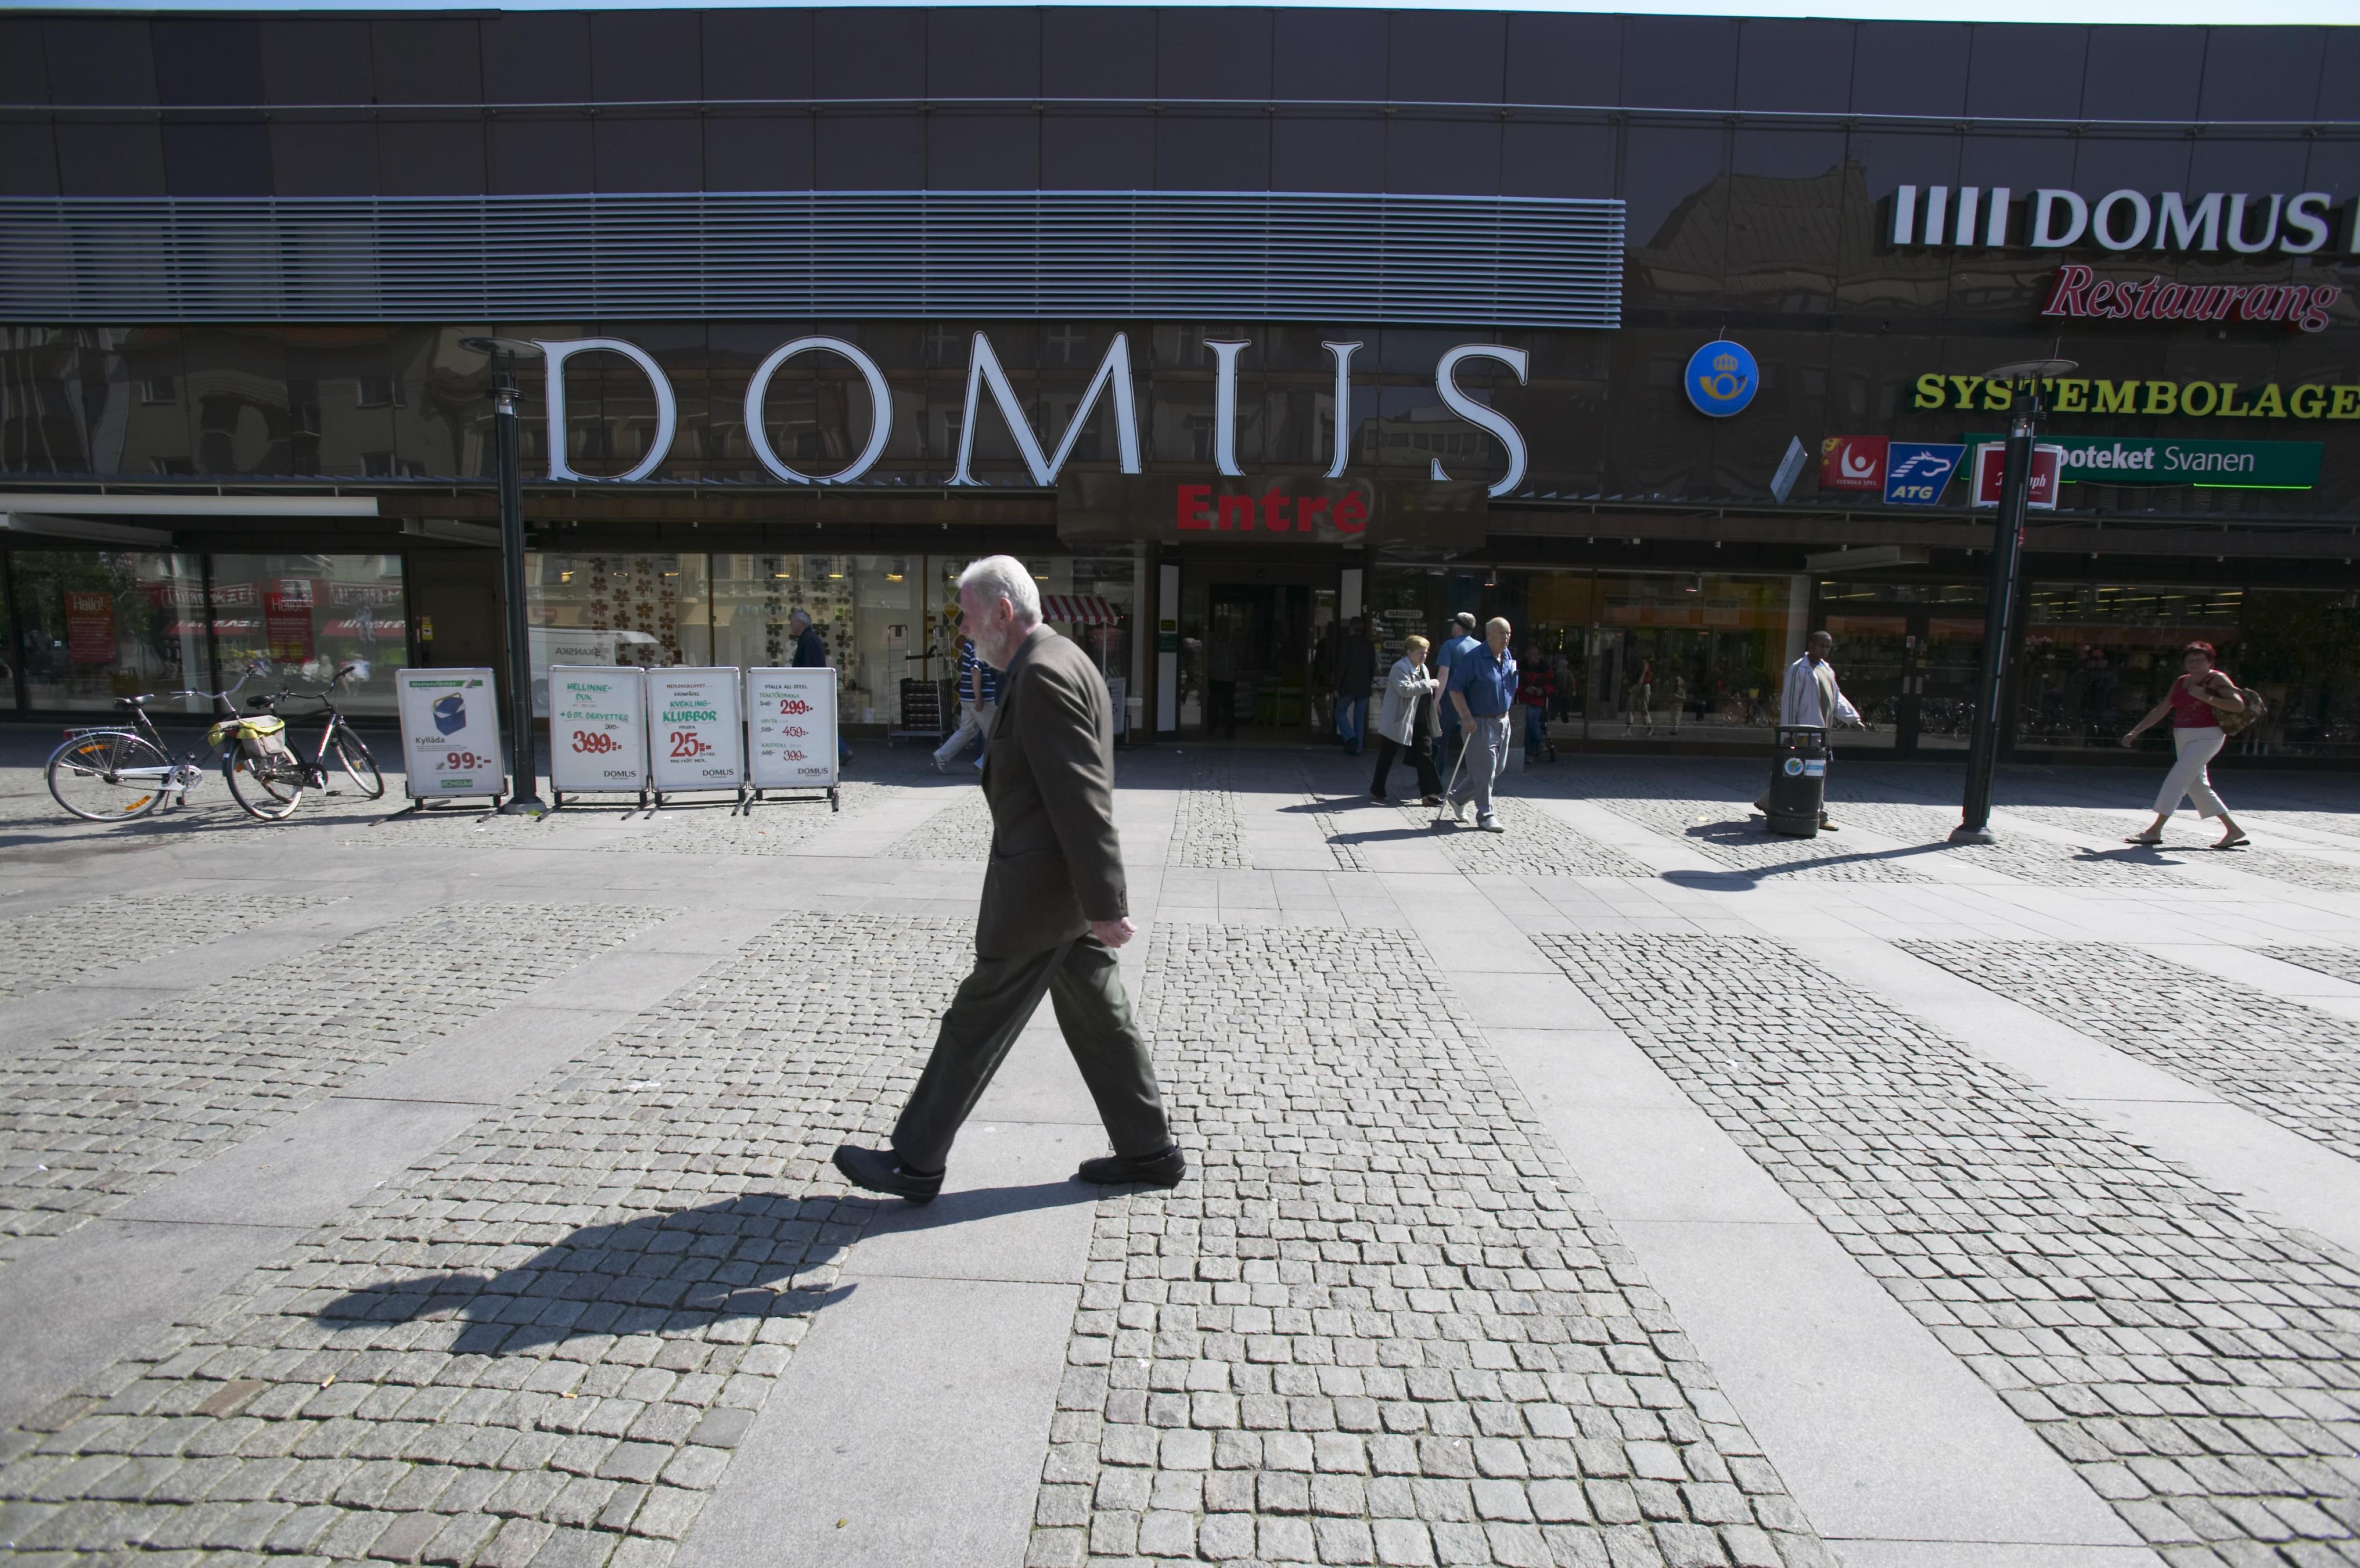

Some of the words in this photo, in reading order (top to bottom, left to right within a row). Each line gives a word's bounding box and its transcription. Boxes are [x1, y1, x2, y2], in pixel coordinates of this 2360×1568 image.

[2031, 188, 2332, 253] DOMUS
[2042, 265, 2341, 333] Restaurang
[530, 330, 1529, 498] DOMUS
[2059, 443, 2155, 470] oteket
[2164, 445, 2255, 472] Svanen
[1891, 485, 1940, 500] ATG
[1177, 484, 1367, 533] Entré
[73, 596, 104, 611] Hello!
[272, 596, 303, 612] Hello!
[567, 682, 613, 692] HELLINNE-
[575, 693, 594, 701] DUK
[670, 700, 711, 708] KYCKLING-
[780, 699, 814, 715] 299:-
[585, 712, 629, 722] SERVETTER
[663, 710, 717, 722] KLUBBOR
[782, 726, 809, 738] 459:-
[415, 736, 445, 745] Kyllåda
[571, 730, 623, 754] 399:-
[670, 731, 712, 757] 25:-
[447, 751, 492, 769] 99:-
[783, 750, 808, 761] 399:-
[702, 768, 734, 776] DOMUS
